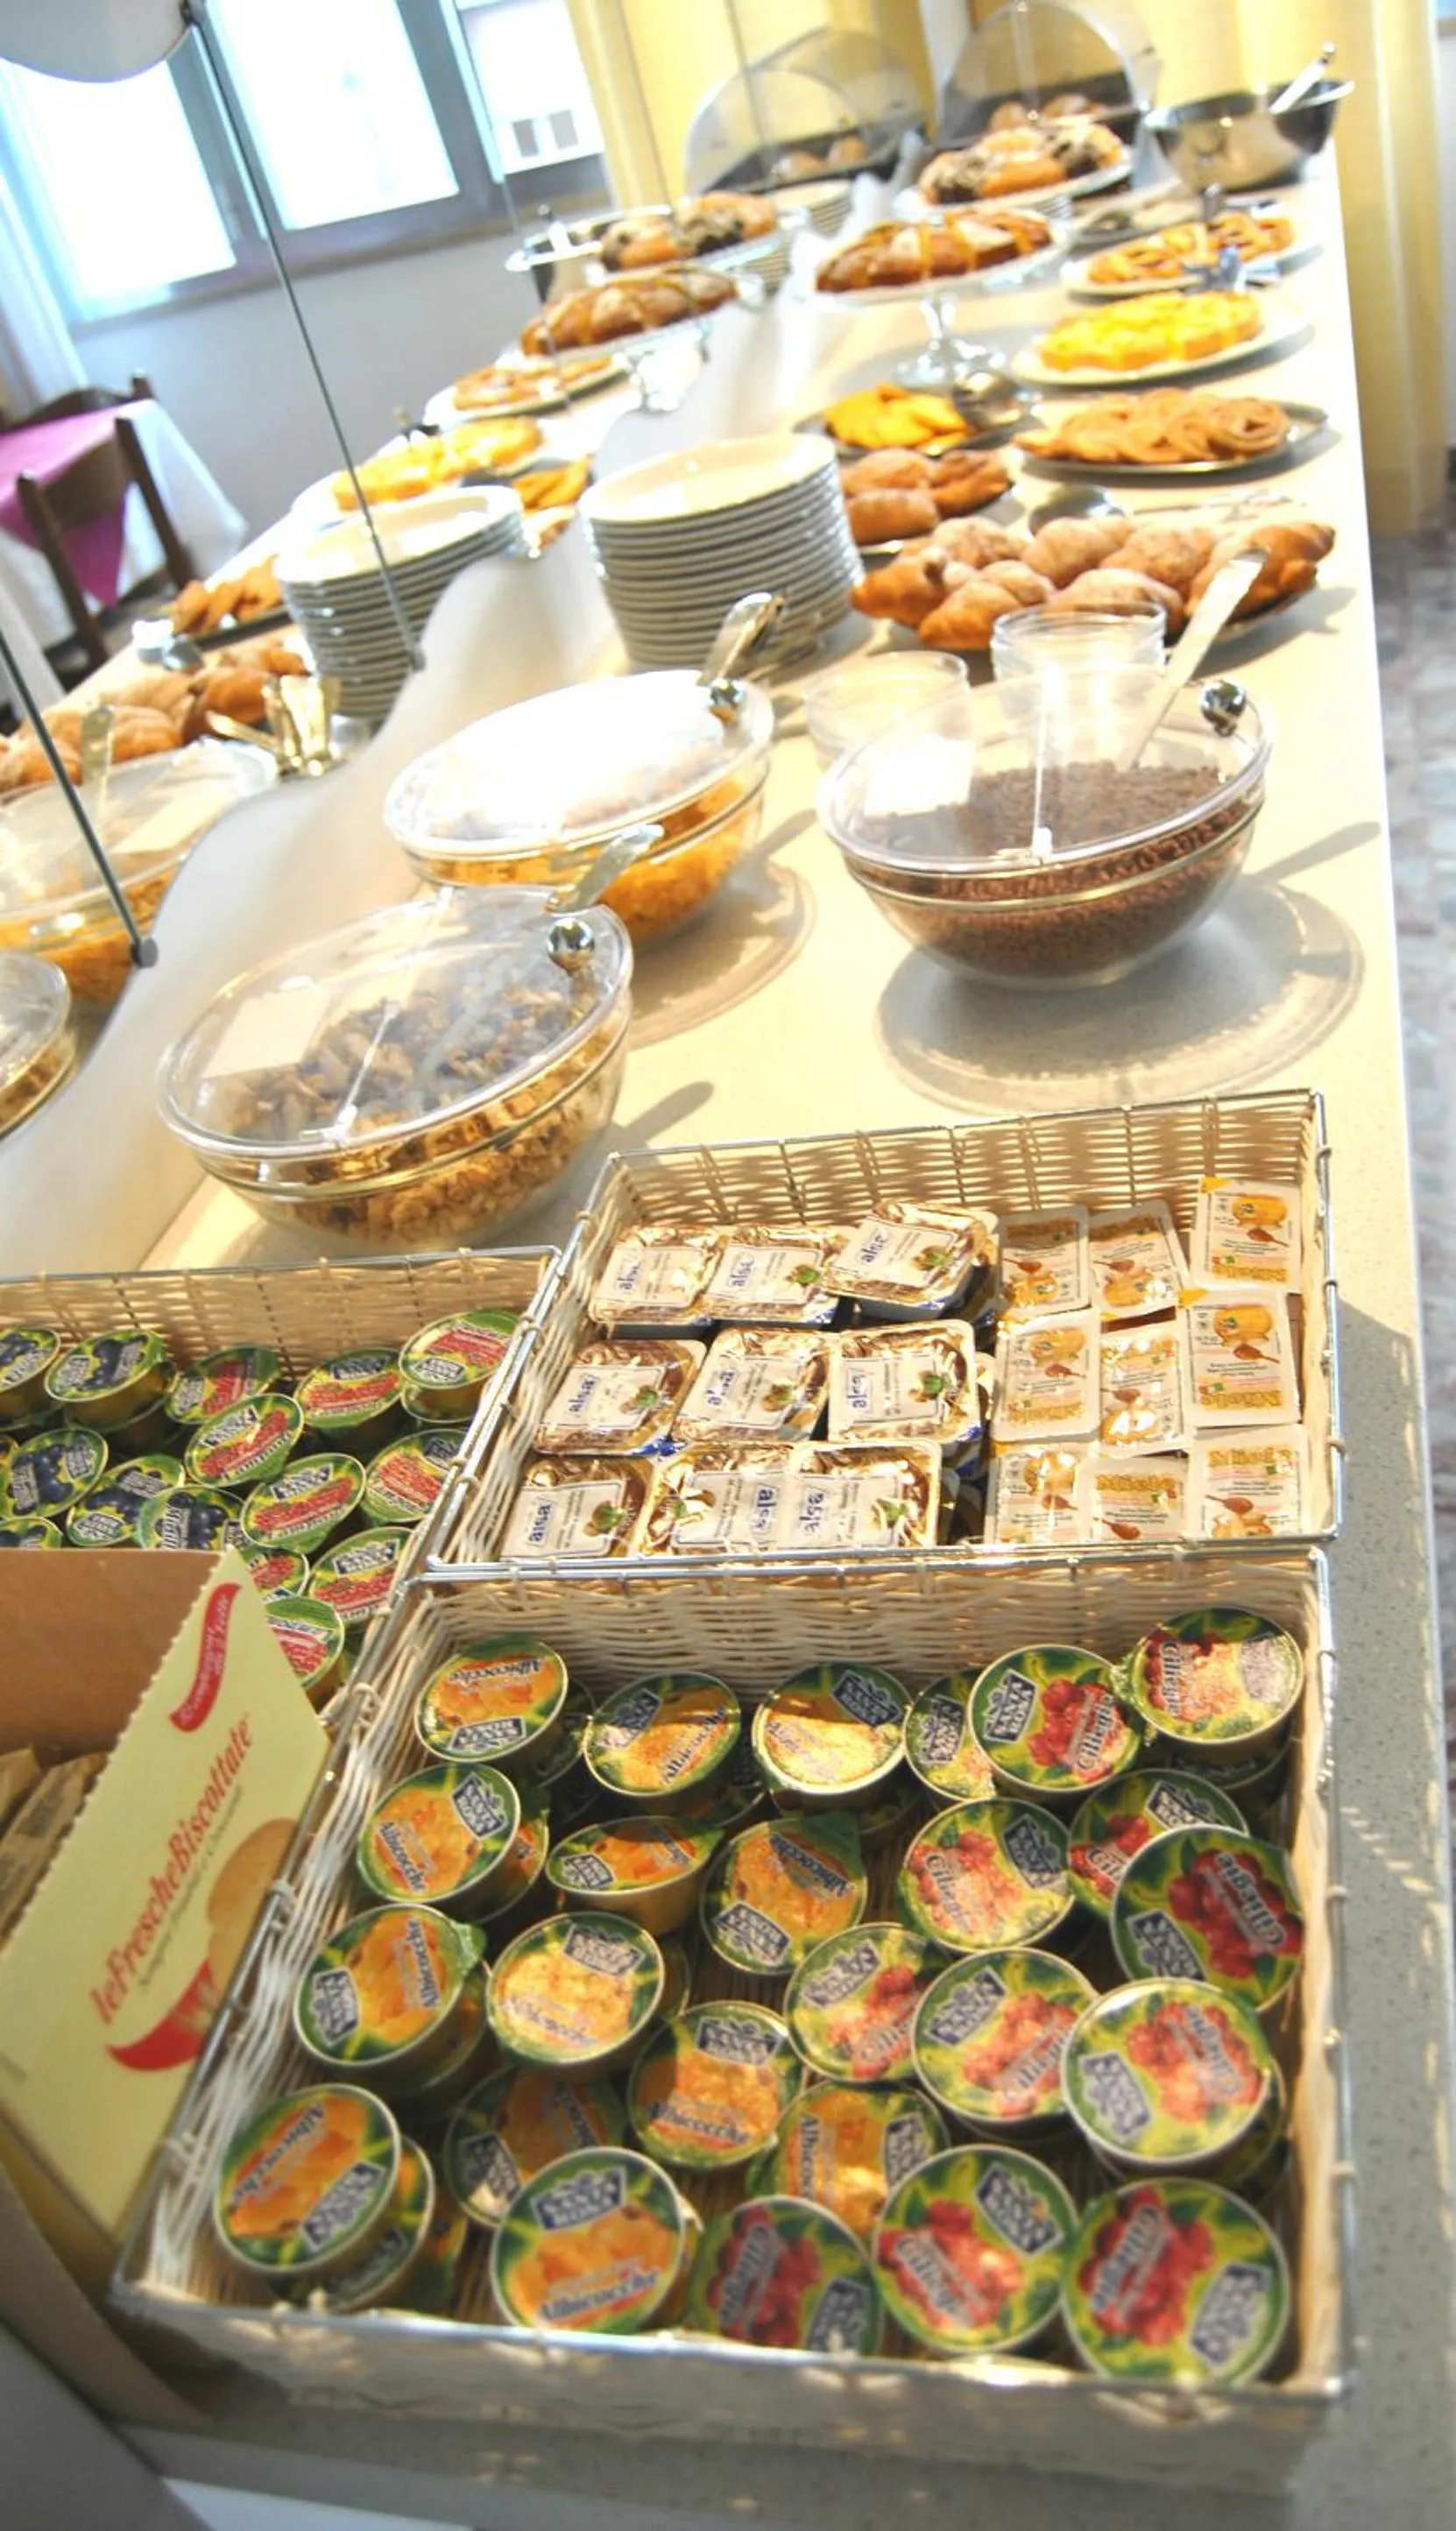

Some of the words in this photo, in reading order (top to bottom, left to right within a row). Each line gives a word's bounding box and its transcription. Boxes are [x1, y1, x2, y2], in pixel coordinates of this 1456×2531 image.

[447, 1655, 541, 1690] Albicocche
[990, 1678, 1028, 1737] SANTA
[1158, 1641, 1188, 1719] Ciliegie
[1005, 1685, 1037, 1736] ROSA
[1069, 1688, 1122, 1774] Ciliegie
[453, 1793, 487, 1835] ROSA
[461, 1785, 498, 1833] SANTA
[375, 1819, 432, 1897] Albicocche
[763, 1832, 850, 1898] Albicocche
[1207, 1847, 1290, 1951] Ciliegie
[398, 1917, 443, 2010] Albicocche
[796, 2114, 822, 2201] Albicoc
